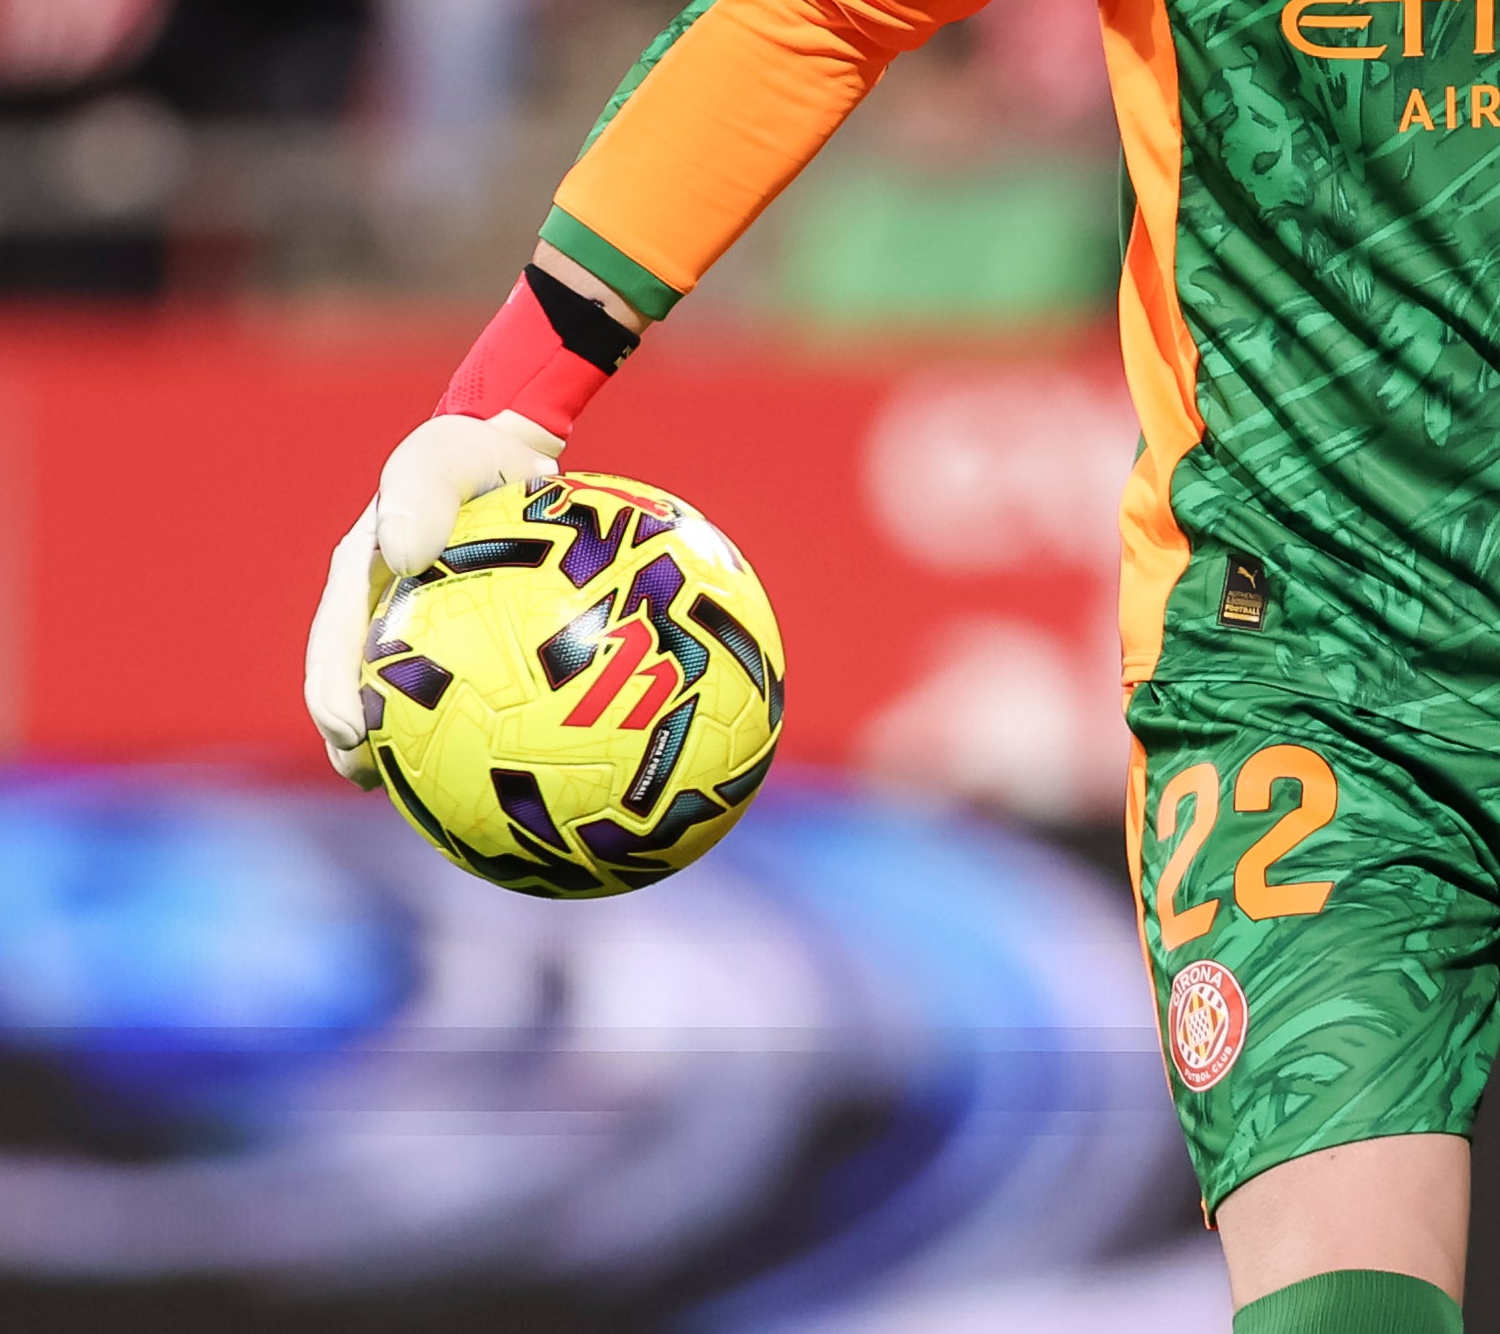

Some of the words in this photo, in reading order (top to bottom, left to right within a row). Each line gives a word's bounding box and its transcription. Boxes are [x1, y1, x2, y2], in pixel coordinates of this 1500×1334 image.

[654, 729, 670, 756] PUMA
[631, 757, 661, 801] FOOTBALL
[1156, 743, 1339, 952] 22
[1172, 965, 1223, 1007] GIRONA
[1211, 1045, 1234, 1074] CLUB
